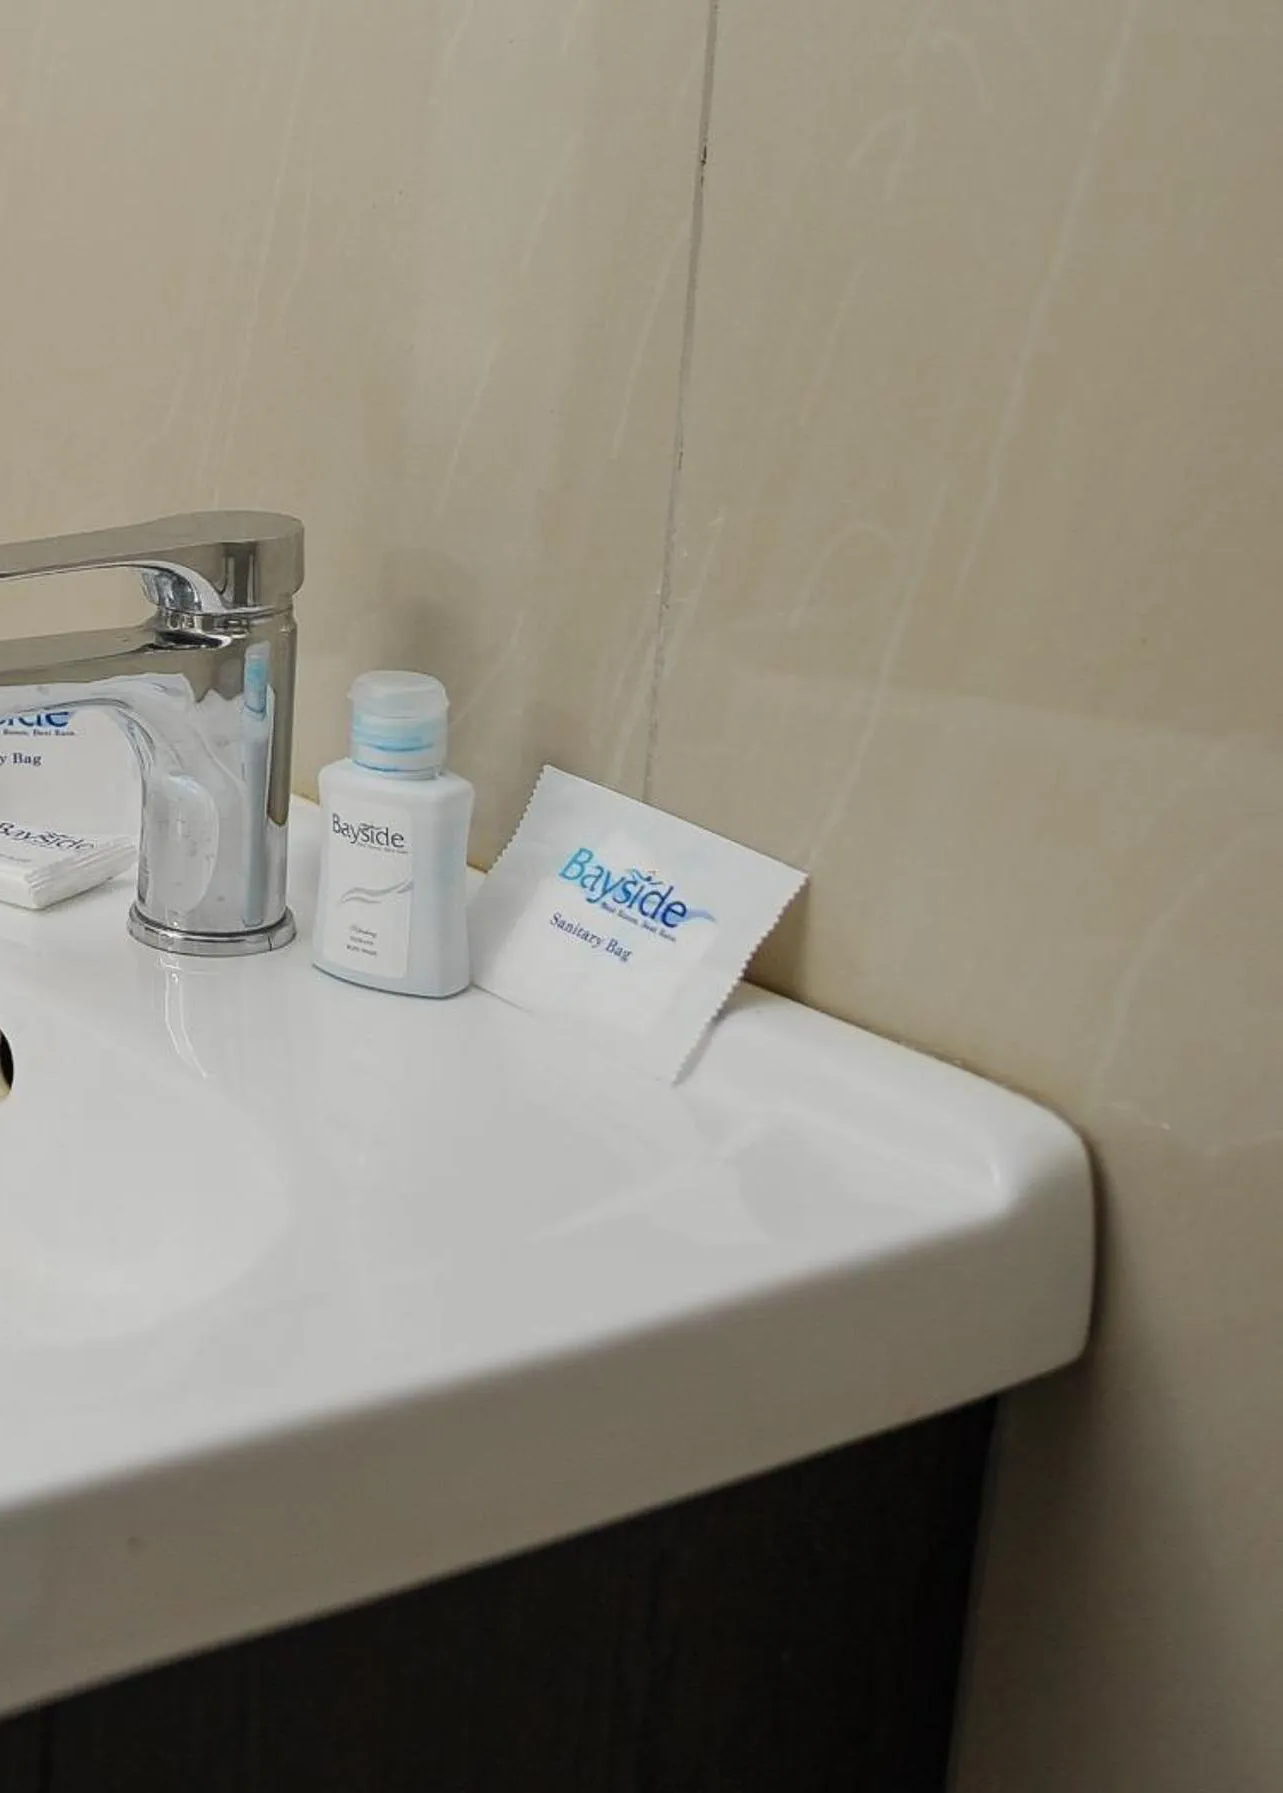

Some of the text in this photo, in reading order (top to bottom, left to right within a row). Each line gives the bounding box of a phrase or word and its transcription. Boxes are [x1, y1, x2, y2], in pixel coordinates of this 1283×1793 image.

[13, 752, 42, 766] Bag
[332, 813, 405, 848] Bayside
[559, 847, 688, 928] Bayside
[550, 912, 605, 949] Sanitary
[605, 938, 633, 962] Bag
